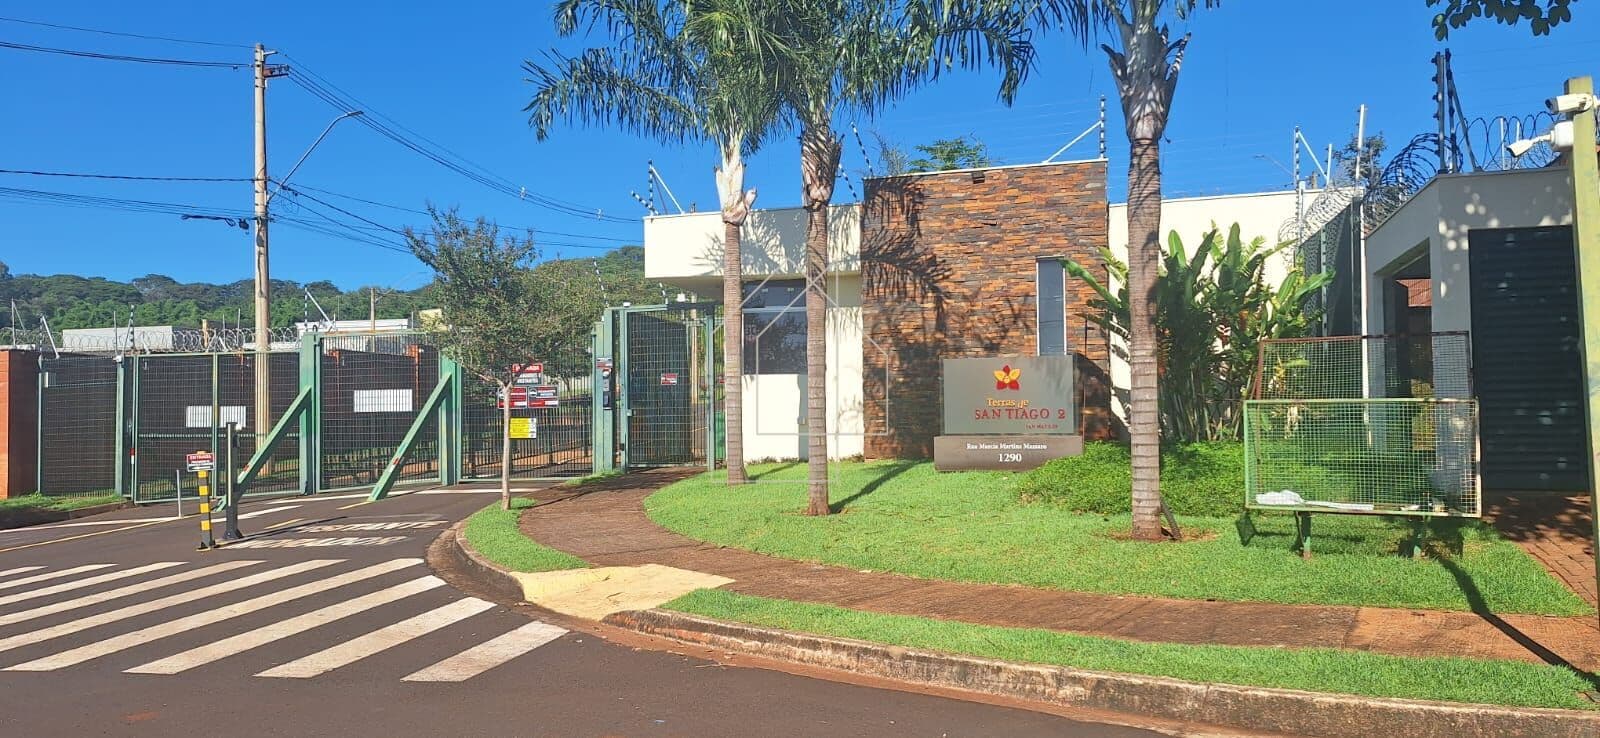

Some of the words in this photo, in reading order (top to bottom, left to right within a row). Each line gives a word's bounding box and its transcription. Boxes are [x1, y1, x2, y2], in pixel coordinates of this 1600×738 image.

[987, 399, 1015, 407] Terras
[1017, 399, 1029, 409] de
[1058, 408, 1066, 420] 2
[998, 453, 1022, 462] 1290
